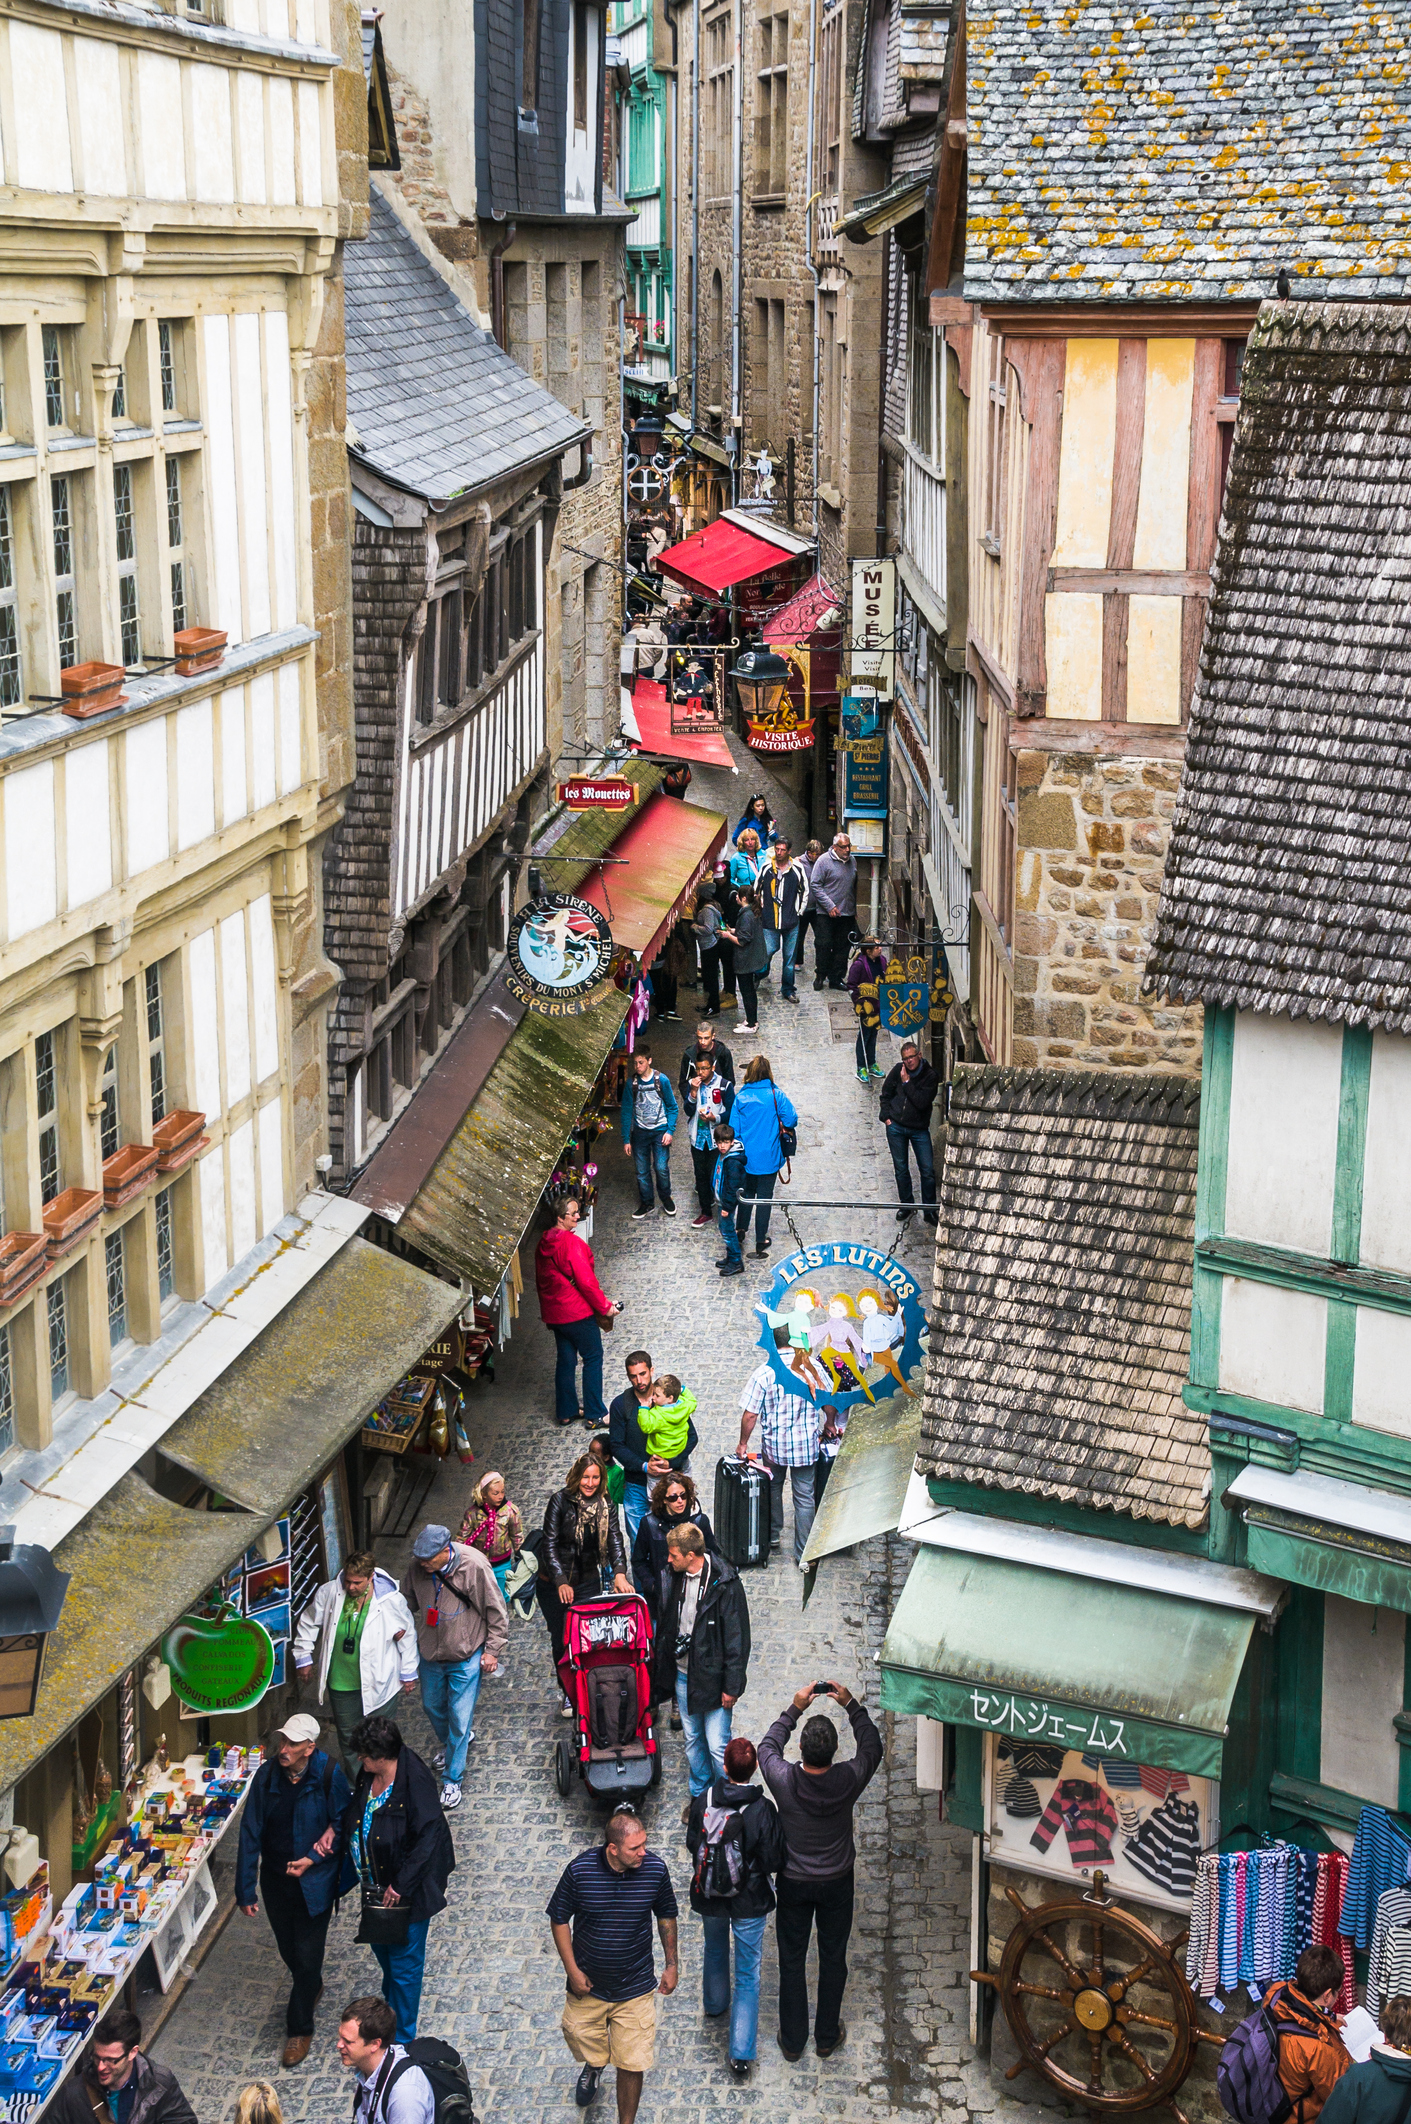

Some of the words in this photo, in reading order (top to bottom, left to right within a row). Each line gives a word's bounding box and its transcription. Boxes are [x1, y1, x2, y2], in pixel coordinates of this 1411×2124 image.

[750, 736, 812, 750] HISTORIQUE
[764, 731, 799, 741] VISITE
[852, 774, 881, 782] RESTAURANT
[564, 786, 580, 799] les
[581, 786, 631, 800] Mouettes
[852, 791, 880, 800] BRASSERIE
[509, 925, 535, 986] SOUVENIRS
[535, 984, 550, 995] DU
[553, 984, 584, 998] MONT
[592, 936, 612, 980] MICHEL
[833, 1246, 915, 1300] LUTINS
[428, 1343, 452, 1355] RIE
[201, 1677, 240, 1685] GATEAUX
[171, 1672, 212, 1707] PRODUITS
[215, 1673, 267, 1709] REGIONAUX
[970, 1689, 1127, 1754] セントジェームス
